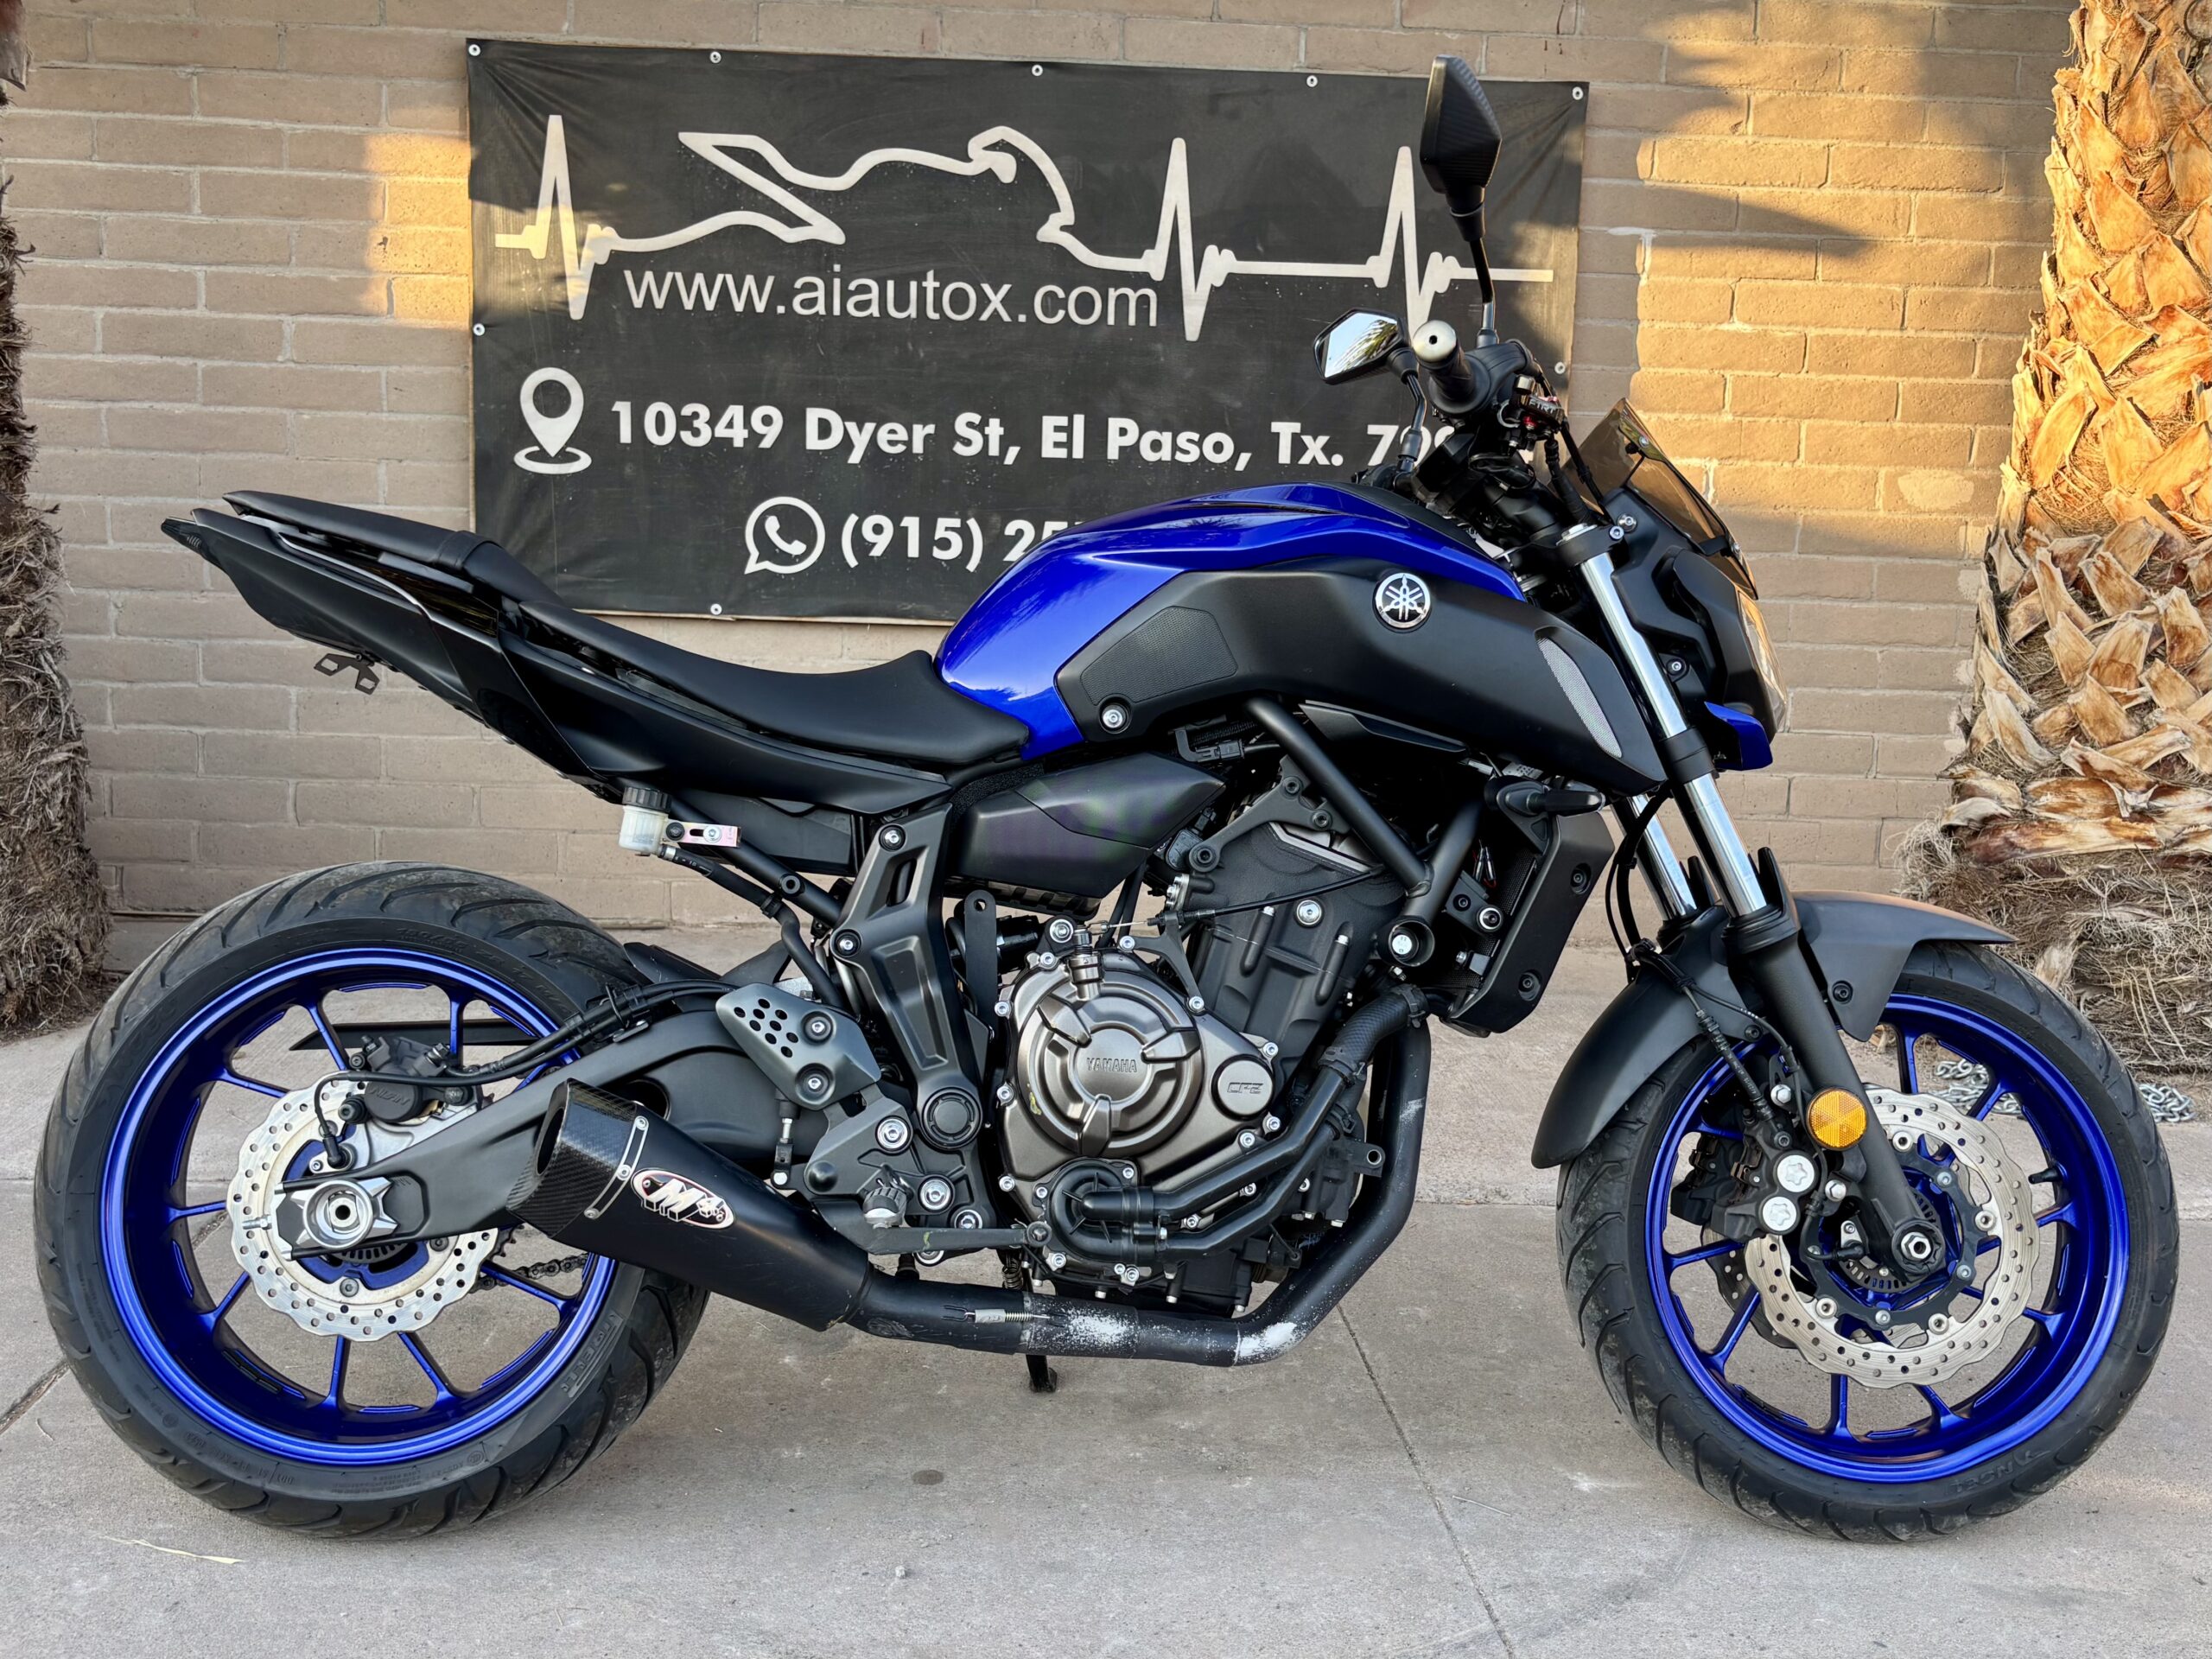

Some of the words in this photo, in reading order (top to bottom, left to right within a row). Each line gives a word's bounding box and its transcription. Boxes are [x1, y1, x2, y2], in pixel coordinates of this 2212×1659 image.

[624, 264, 1158, 327] www.aiautox.com
[612, 401, 783, 449] 10349
[805, 408, 936, 463] Dyer
[952, 412, 1021, 465] St,
[1040, 414, 1085, 460] El
[1106, 417, 1252, 471] Paso,
[1270, 422, 1344, 466] Tx.
[841, 513, 983, 572] (915)
[1086, 1057, 1138, 1072] YAMAHA
